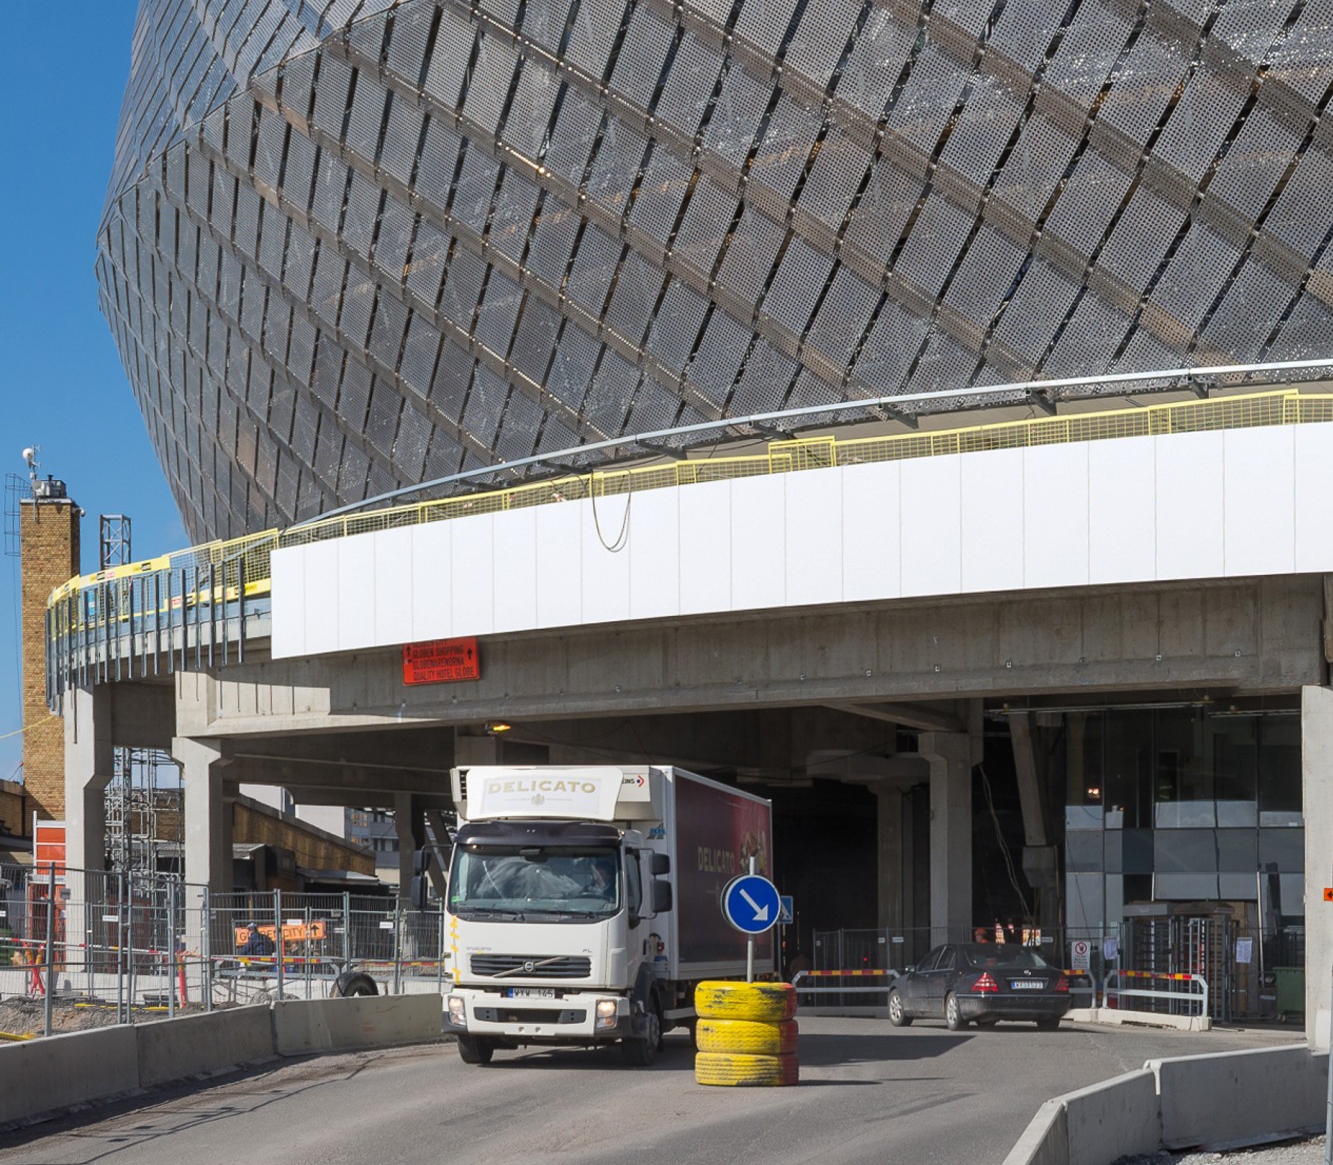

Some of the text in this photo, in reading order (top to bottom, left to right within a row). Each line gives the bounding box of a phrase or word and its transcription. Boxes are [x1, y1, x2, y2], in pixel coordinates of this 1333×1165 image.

[488, 780, 596, 794] DELICATO
[698, 846, 735, 875] DELICATO
[283, 927, 303, 938] CITY
